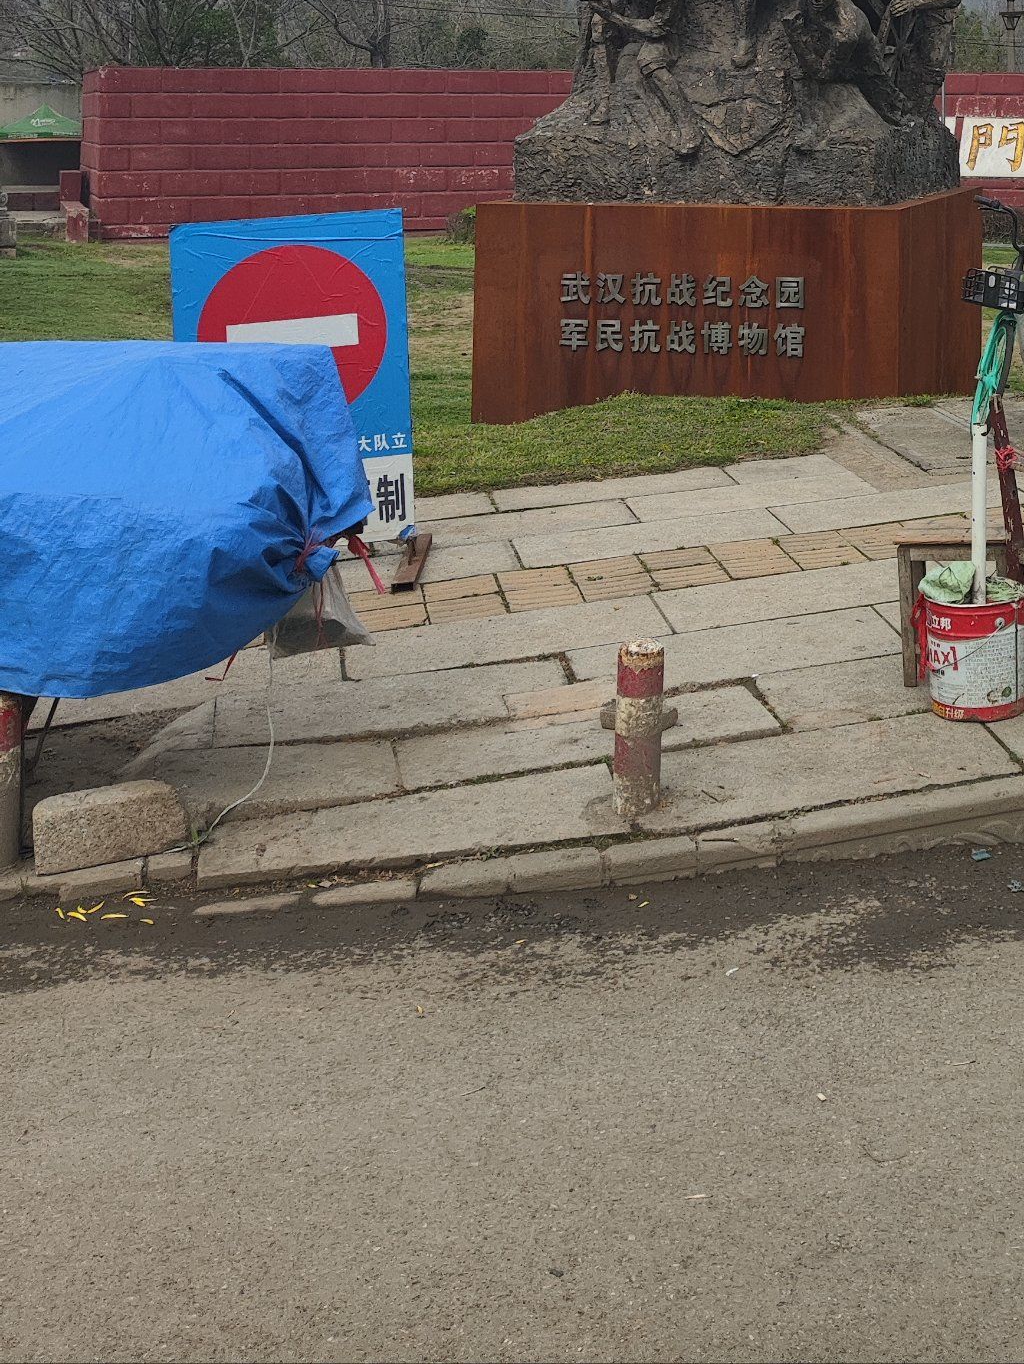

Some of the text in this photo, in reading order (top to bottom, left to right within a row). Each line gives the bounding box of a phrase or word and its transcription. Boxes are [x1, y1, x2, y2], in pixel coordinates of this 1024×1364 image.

[560, 272, 805, 309] 武汉抗战纪念园
[559, 318, 805, 358] 军民抗战博物馆
